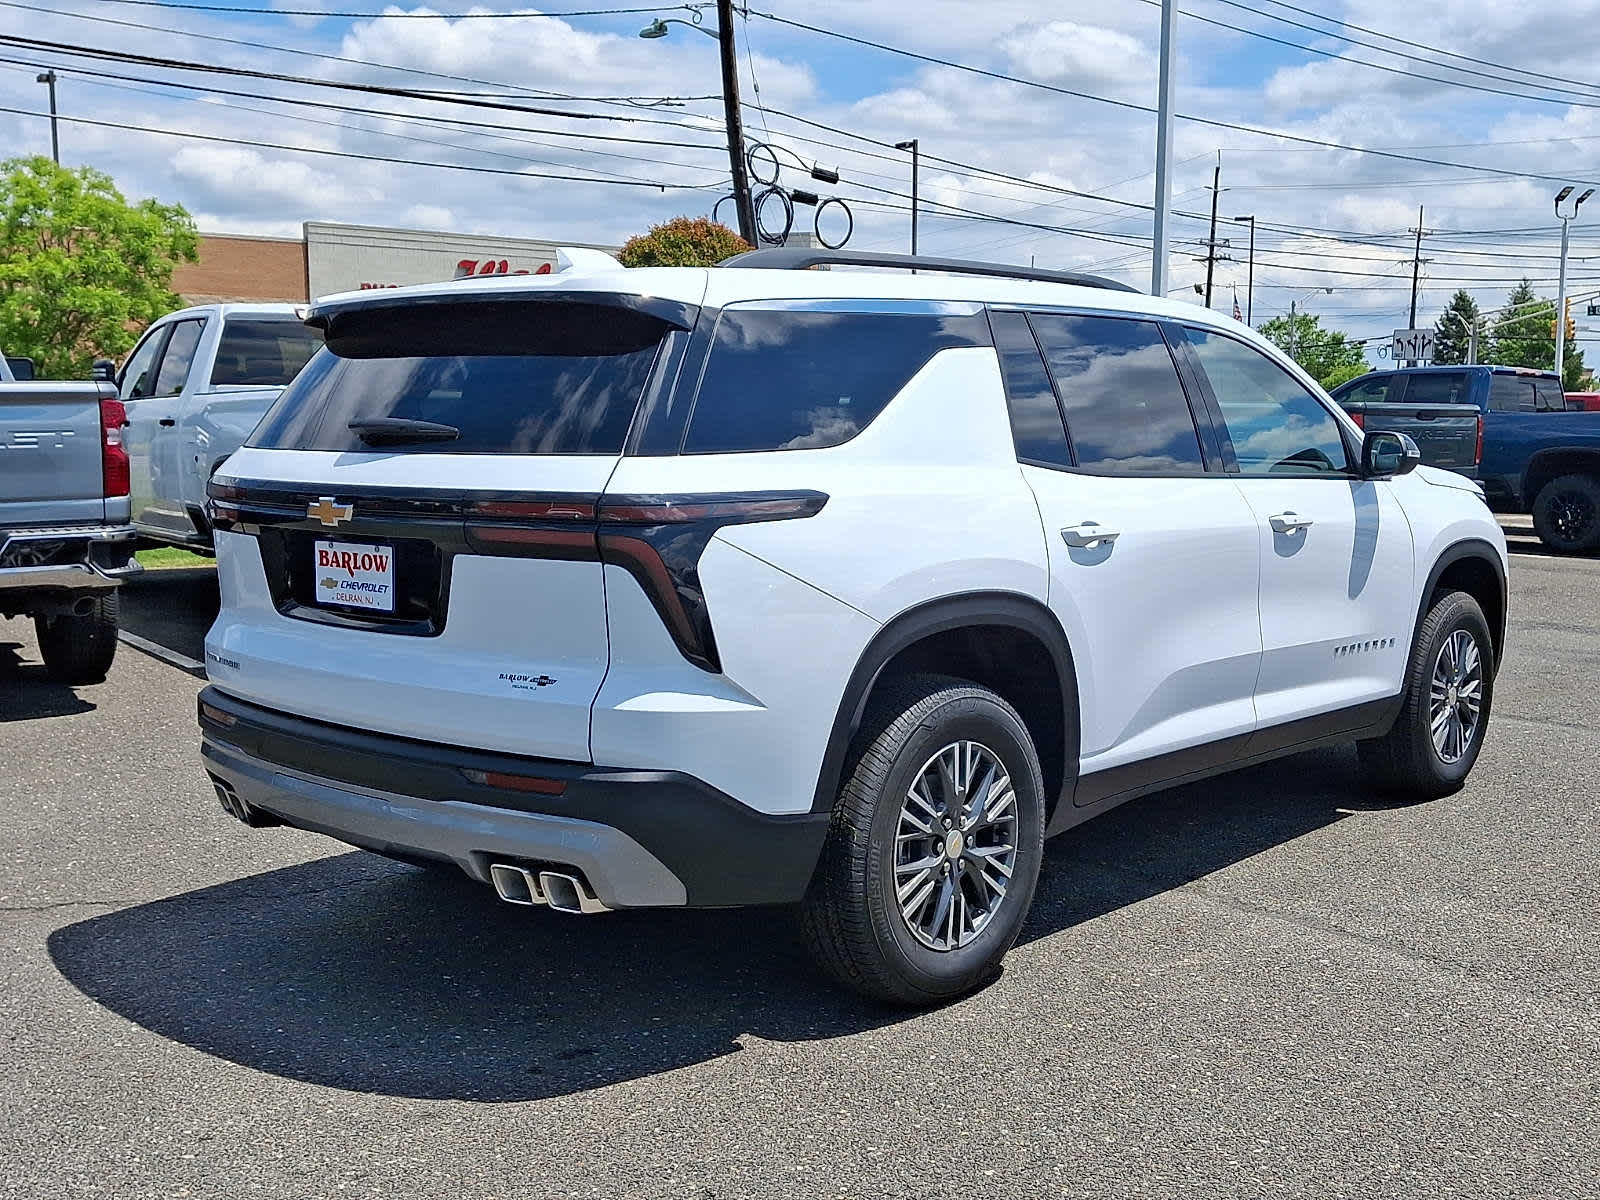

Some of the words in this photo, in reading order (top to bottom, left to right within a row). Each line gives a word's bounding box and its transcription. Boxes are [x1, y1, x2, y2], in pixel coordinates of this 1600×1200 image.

[318, 549, 389, 578] BARLOW
[340, 580, 389, 594] CHEVROLET
[498, 673, 530, 683] BARLOW
